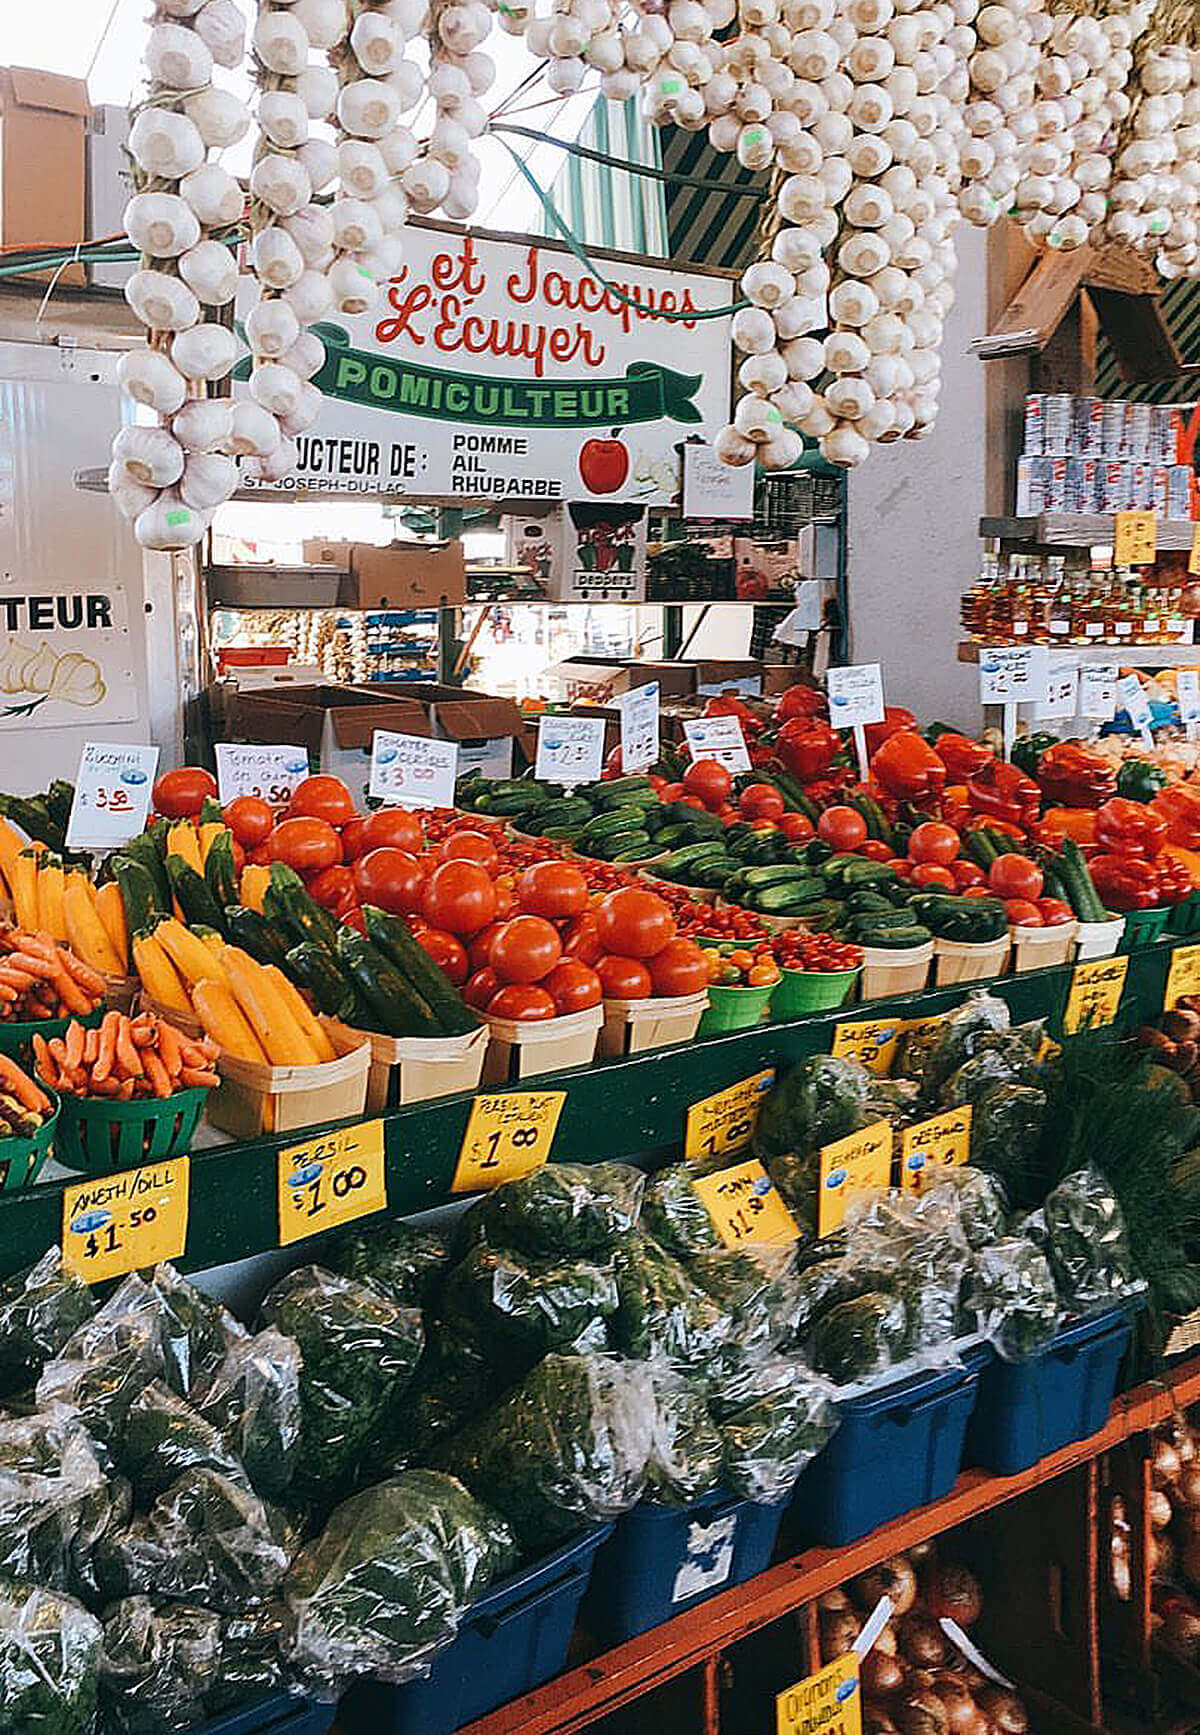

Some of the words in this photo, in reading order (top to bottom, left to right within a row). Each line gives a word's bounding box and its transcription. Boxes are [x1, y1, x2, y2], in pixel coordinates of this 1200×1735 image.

[432, 238, 486, 296] et
[507, 247, 700, 333] Jacques
[337, 358, 629, 418] POMICULTEUR
[296, 437, 380, 476] UCTEUR
[453, 435, 527, 454] POMME
[452, 455, 487, 472] AIL
[452, 476, 562, 496] RHUBARBE
[0, 595, 113, 632] TEUR
